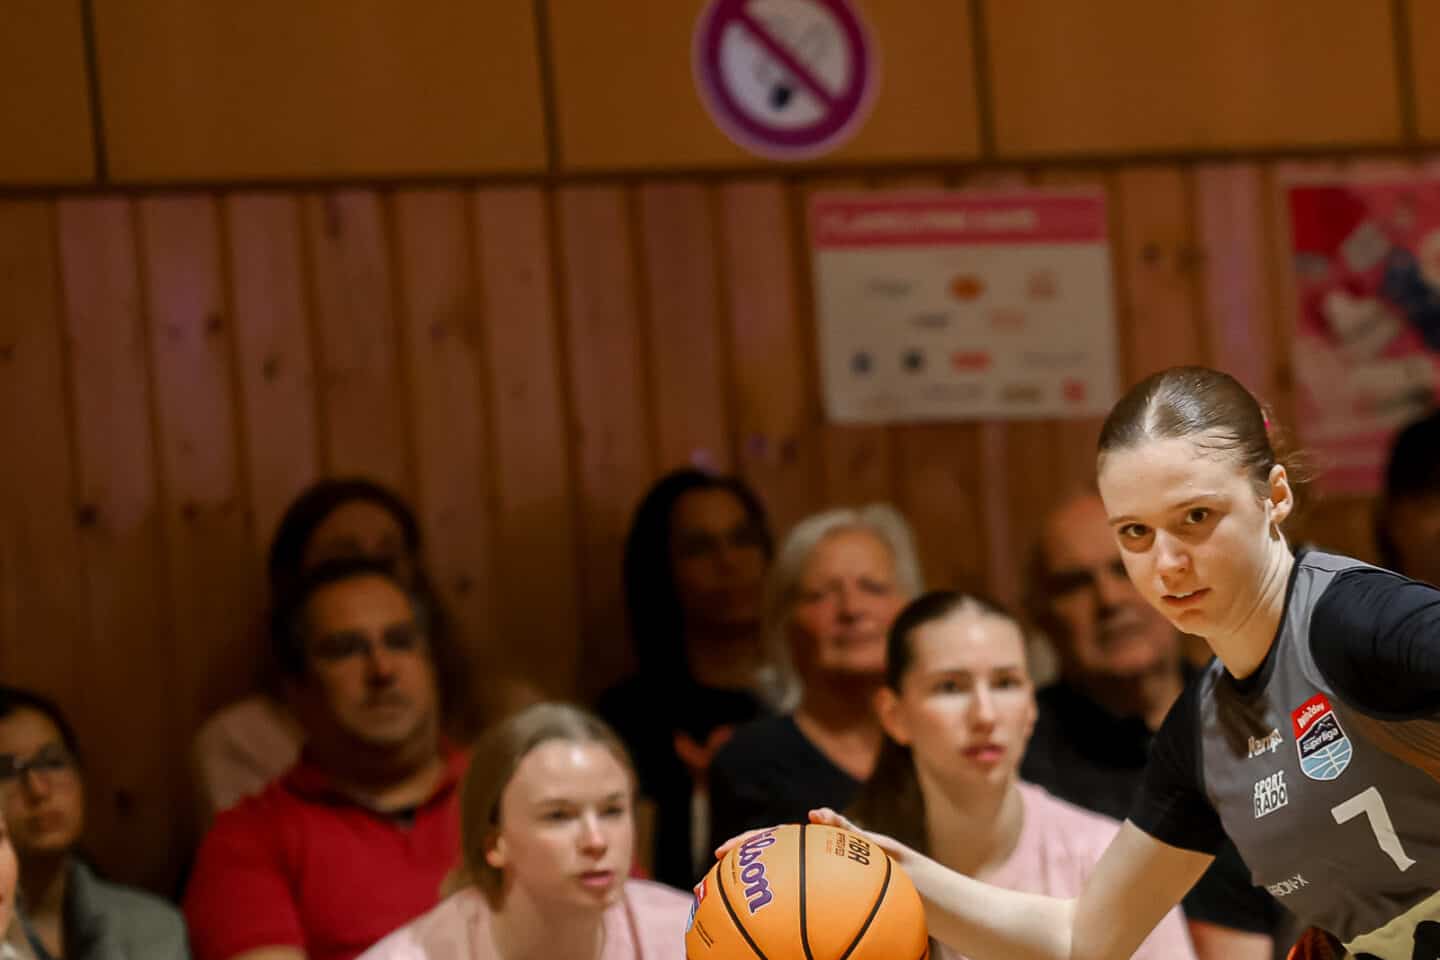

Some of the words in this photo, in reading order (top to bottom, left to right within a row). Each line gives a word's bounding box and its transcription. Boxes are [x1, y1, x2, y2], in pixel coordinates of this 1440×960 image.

[1254, 770, 1285, 794] SPORT
[1255, 784, 1288, 818] RADO
[1331, 785, 1417, 872] 7
[848, 836, 871, 866] FIBA
